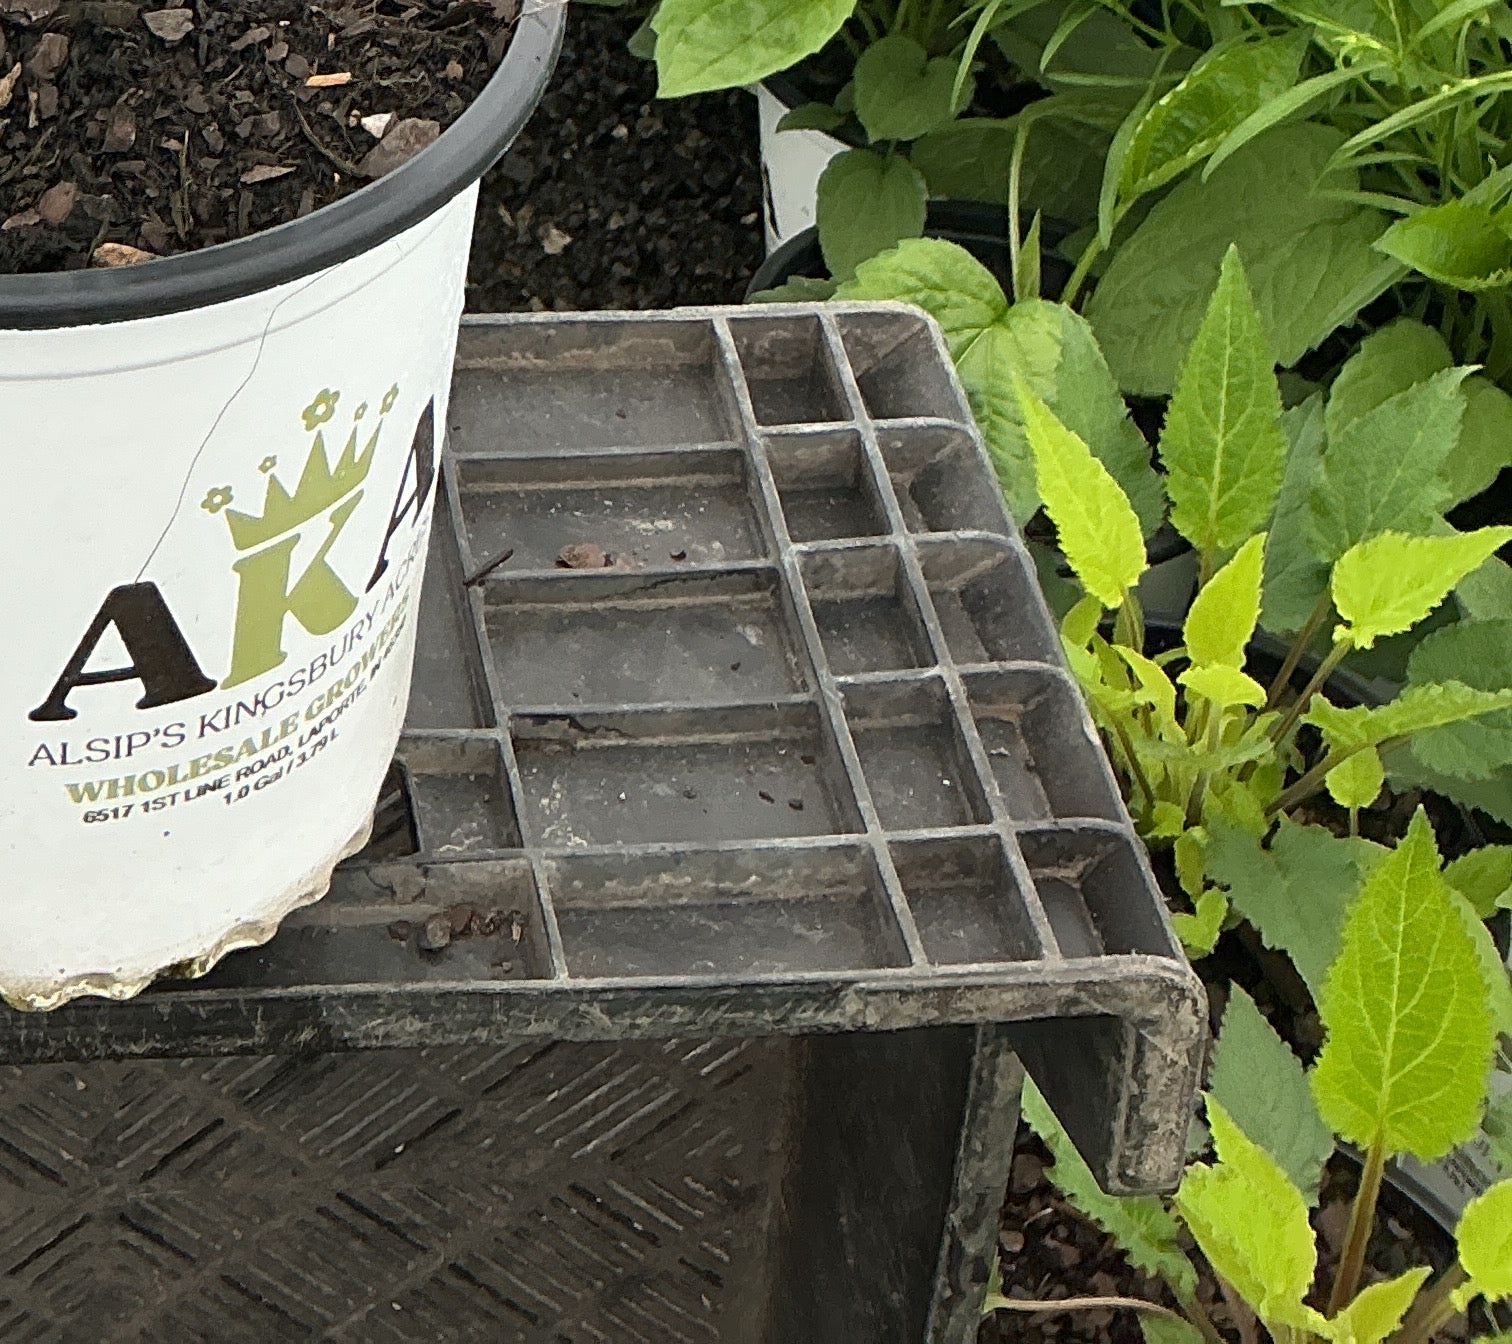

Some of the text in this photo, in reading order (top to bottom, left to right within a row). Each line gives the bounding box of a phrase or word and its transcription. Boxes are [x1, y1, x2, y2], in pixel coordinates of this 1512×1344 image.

[28, 722, 186, 767] ALSIP'S
[198, 599, 380, 739] KINGSBURY
[64, 710, 300, 804] WHOLESALE
[83, 803, 135, 824] 6517
[141, 792, 181, 813] 1ST
[184, 774, 232, 802] LINE
[298, 678, 367, 748] LAPORTE
[223, 784, 251, 806] 1.0
[253, 766, 284, 792] Gal
